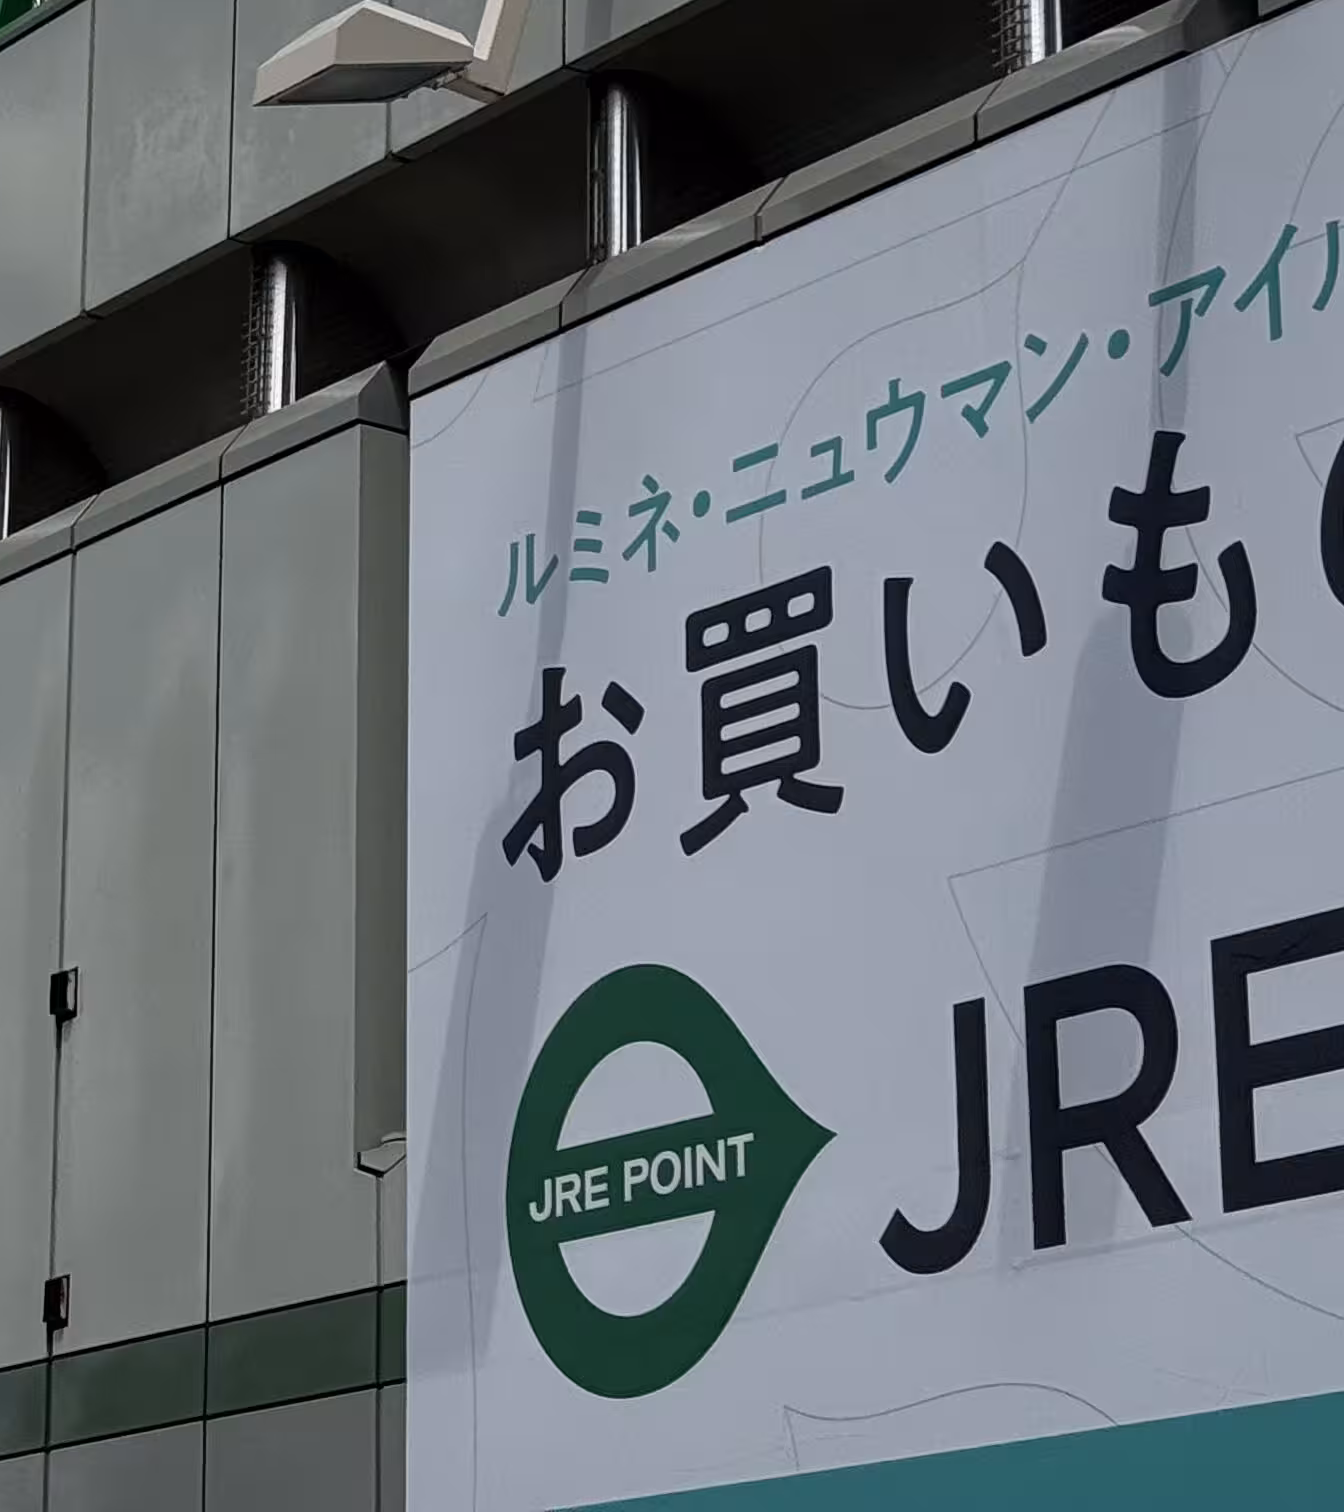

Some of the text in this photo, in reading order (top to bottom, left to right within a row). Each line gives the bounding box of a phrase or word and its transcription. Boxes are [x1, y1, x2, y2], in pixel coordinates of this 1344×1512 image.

[502, 431, 1344, 883] お買いも
[528, 1131, 755, 1223] JRE POINT
